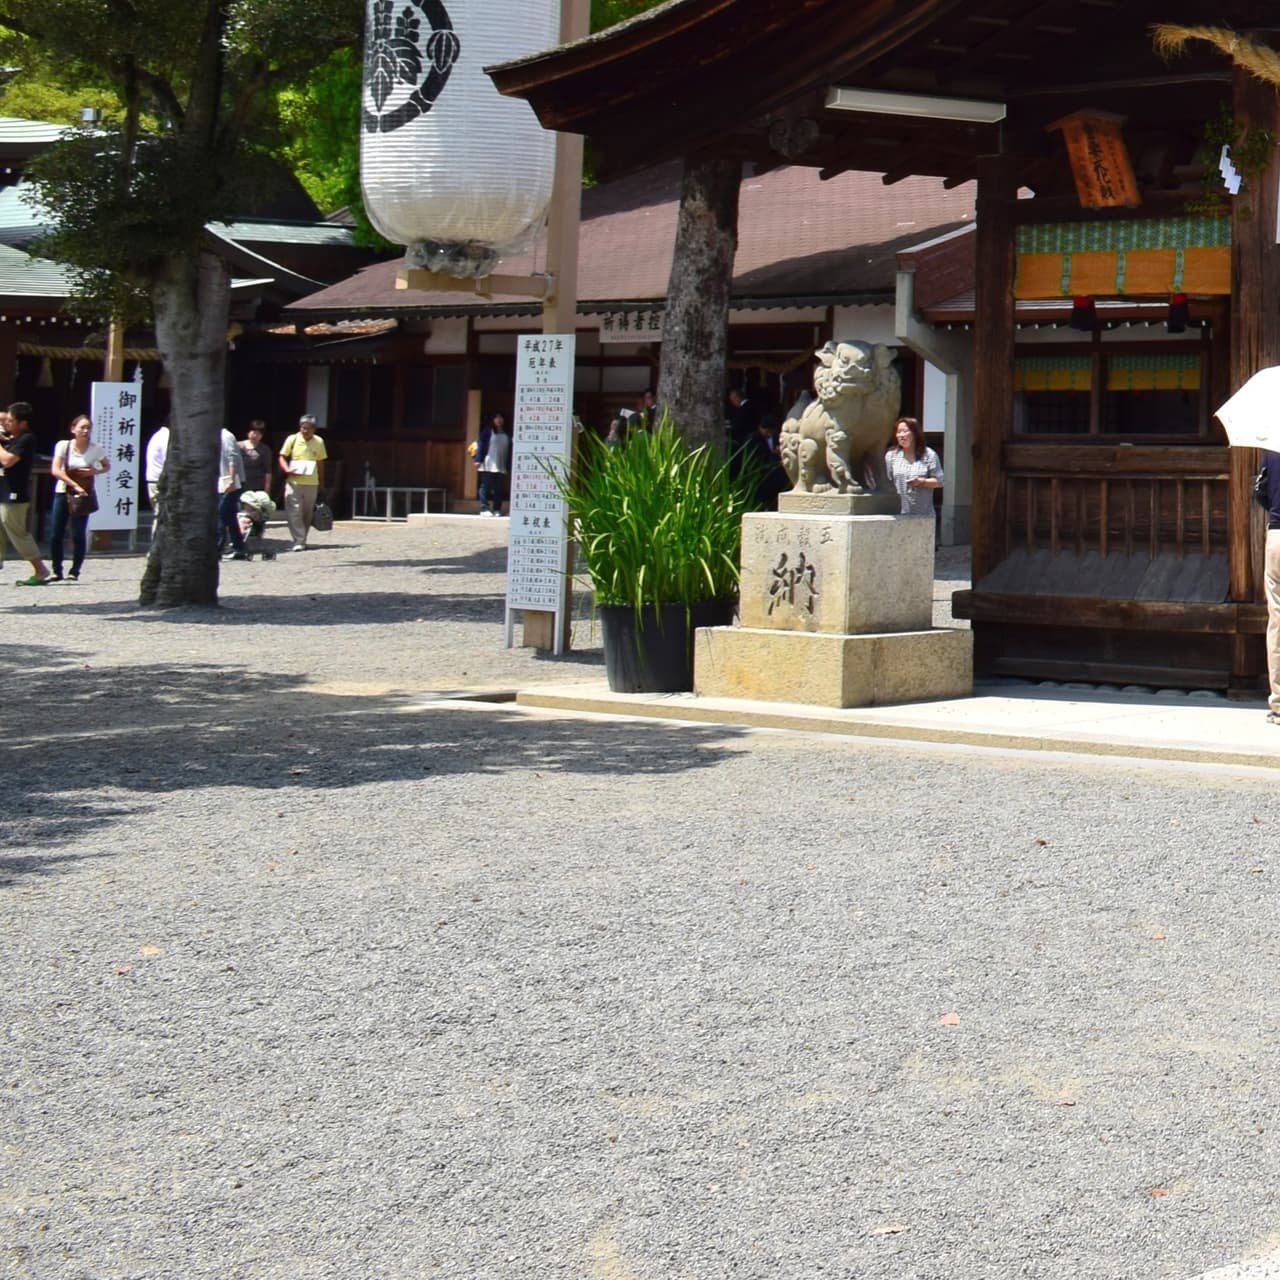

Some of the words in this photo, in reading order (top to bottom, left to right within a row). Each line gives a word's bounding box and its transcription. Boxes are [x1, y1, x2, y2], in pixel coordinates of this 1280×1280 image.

[524, 338, 564, 353] 平成27年
[114, 390, 137, 516] 御祈祷受付
[768, 552, 820, 615] 納
